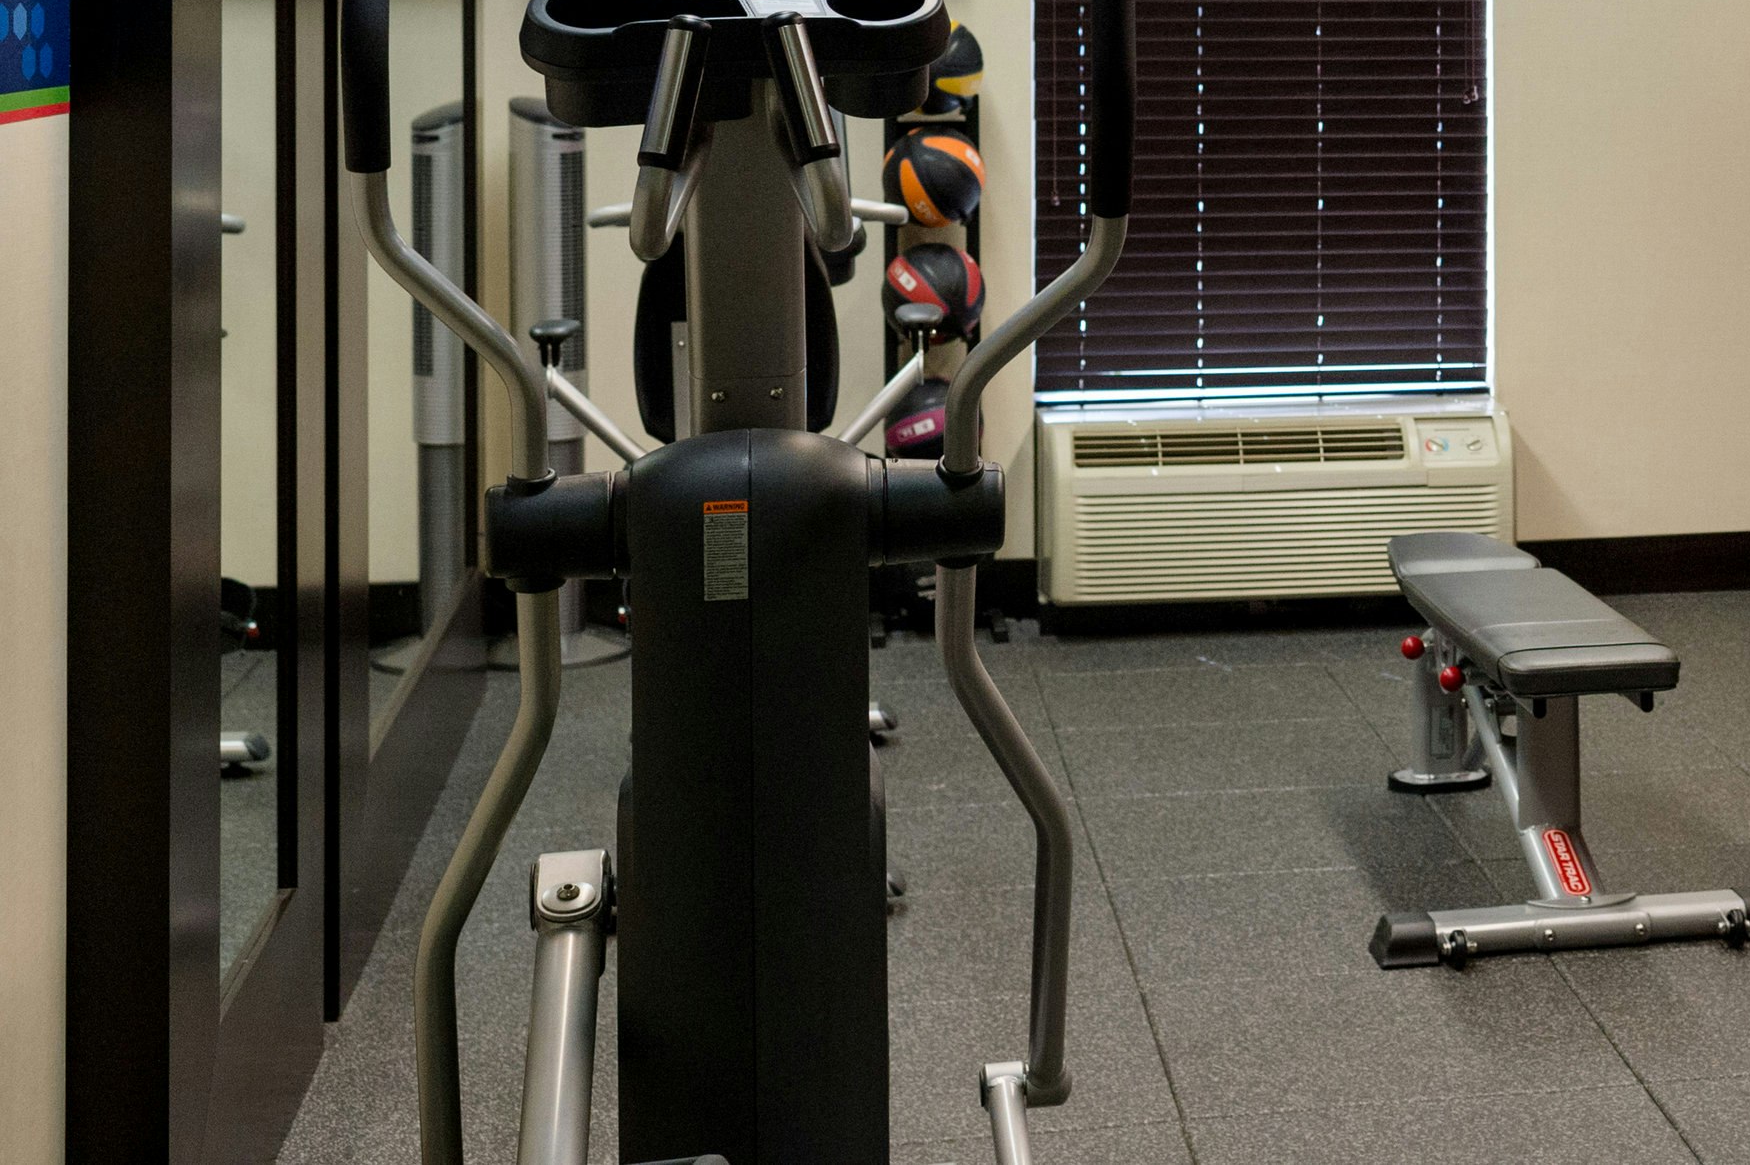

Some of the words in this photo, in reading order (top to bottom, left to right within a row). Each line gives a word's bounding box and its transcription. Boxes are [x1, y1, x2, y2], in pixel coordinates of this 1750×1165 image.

[712, 503, 745, 511] WARNING
[1552, 832, 1570, 861] STAR
[1562, 860, 1583, 891] TRAC
